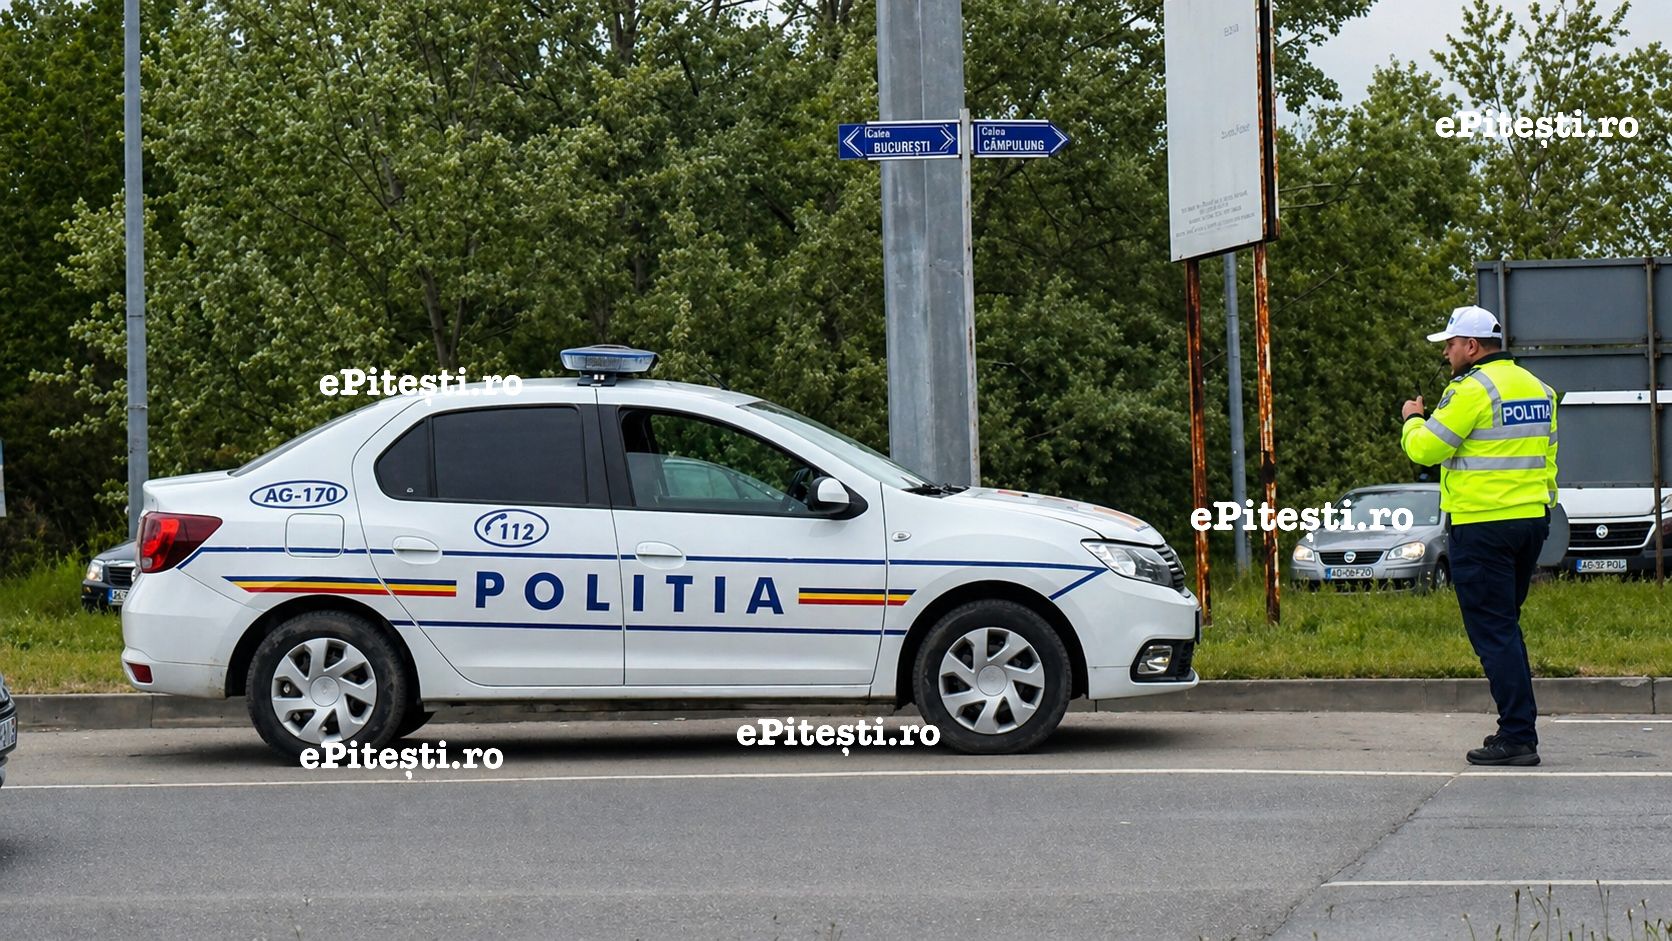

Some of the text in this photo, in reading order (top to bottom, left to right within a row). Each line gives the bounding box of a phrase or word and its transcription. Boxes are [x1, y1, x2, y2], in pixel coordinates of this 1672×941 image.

[983, 137, 1045, 151] CÂMPULUNG
[1502, 403, 1551, 423] POLITIA
[263, 487, 338, 503] AG-170
[500, 523, 534, 541] 112
[475, 571, 785, 615] POLITIA
